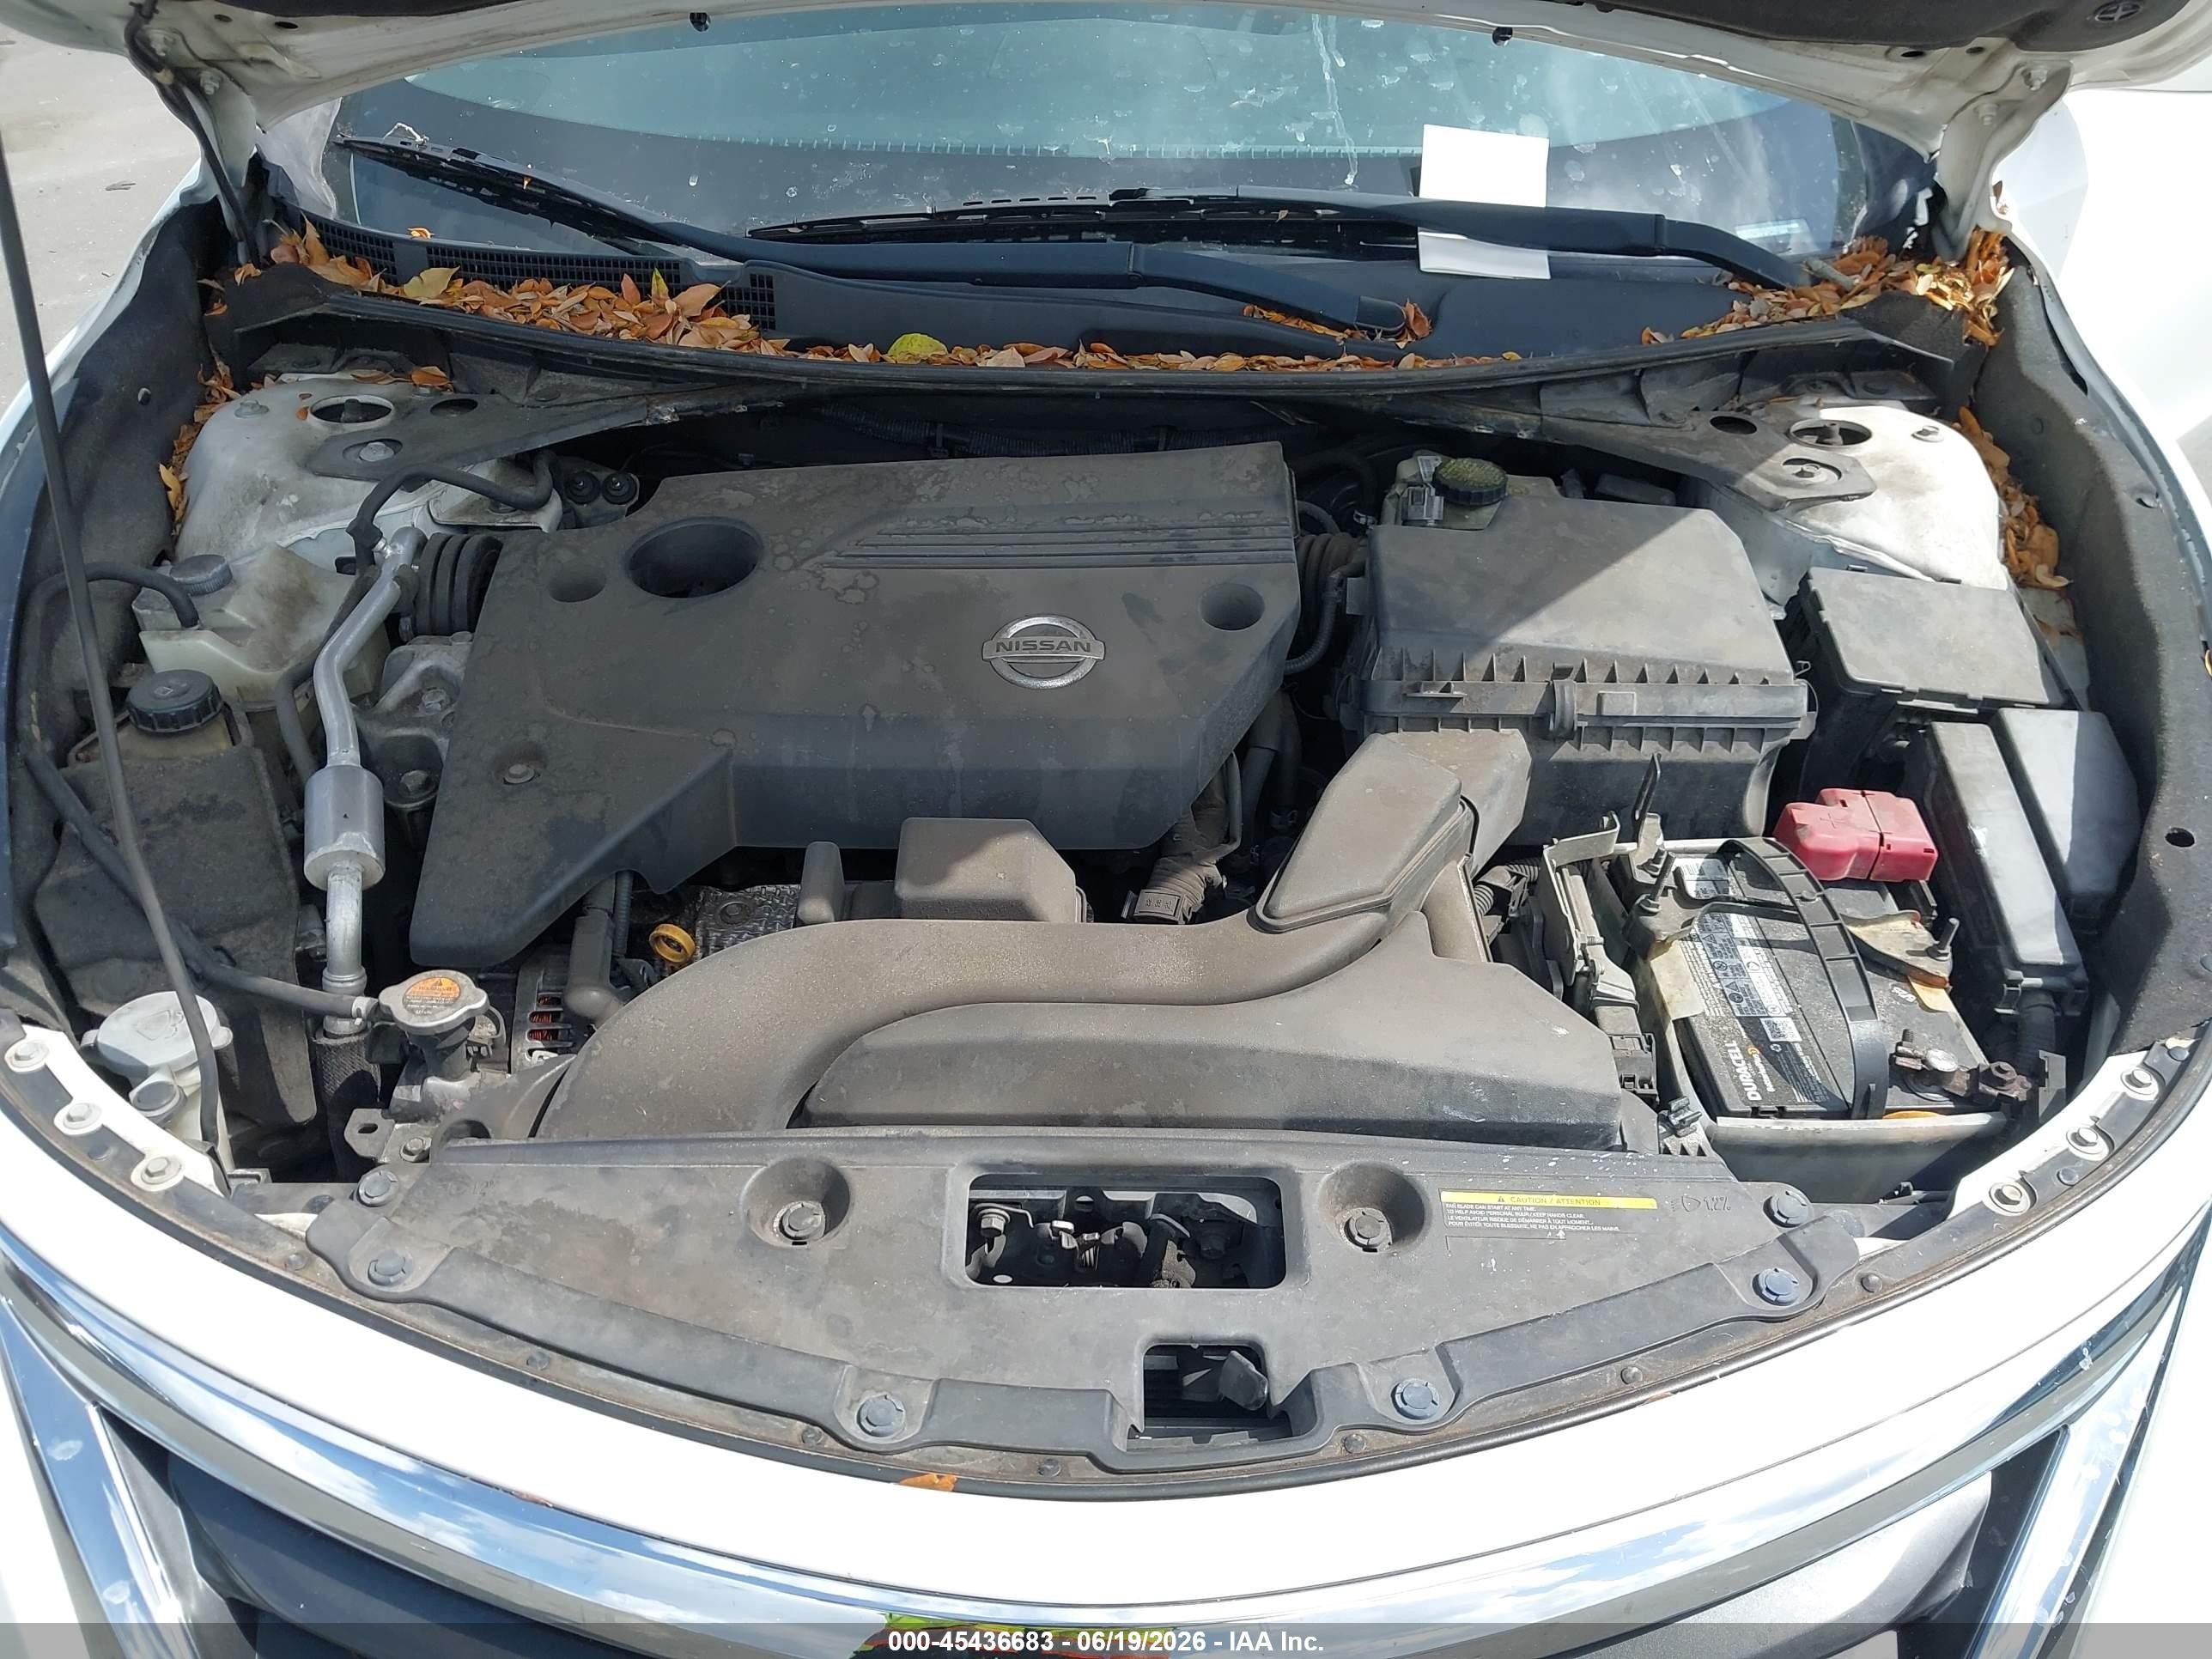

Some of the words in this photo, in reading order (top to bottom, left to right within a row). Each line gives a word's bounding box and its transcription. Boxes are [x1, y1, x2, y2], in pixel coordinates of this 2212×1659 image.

[996, 641, 1091, 653] NISSAN
[1723, 1040, 1762, 1101] DURACELL
[1556, 1197, 1601, 1206] ATTENTION
